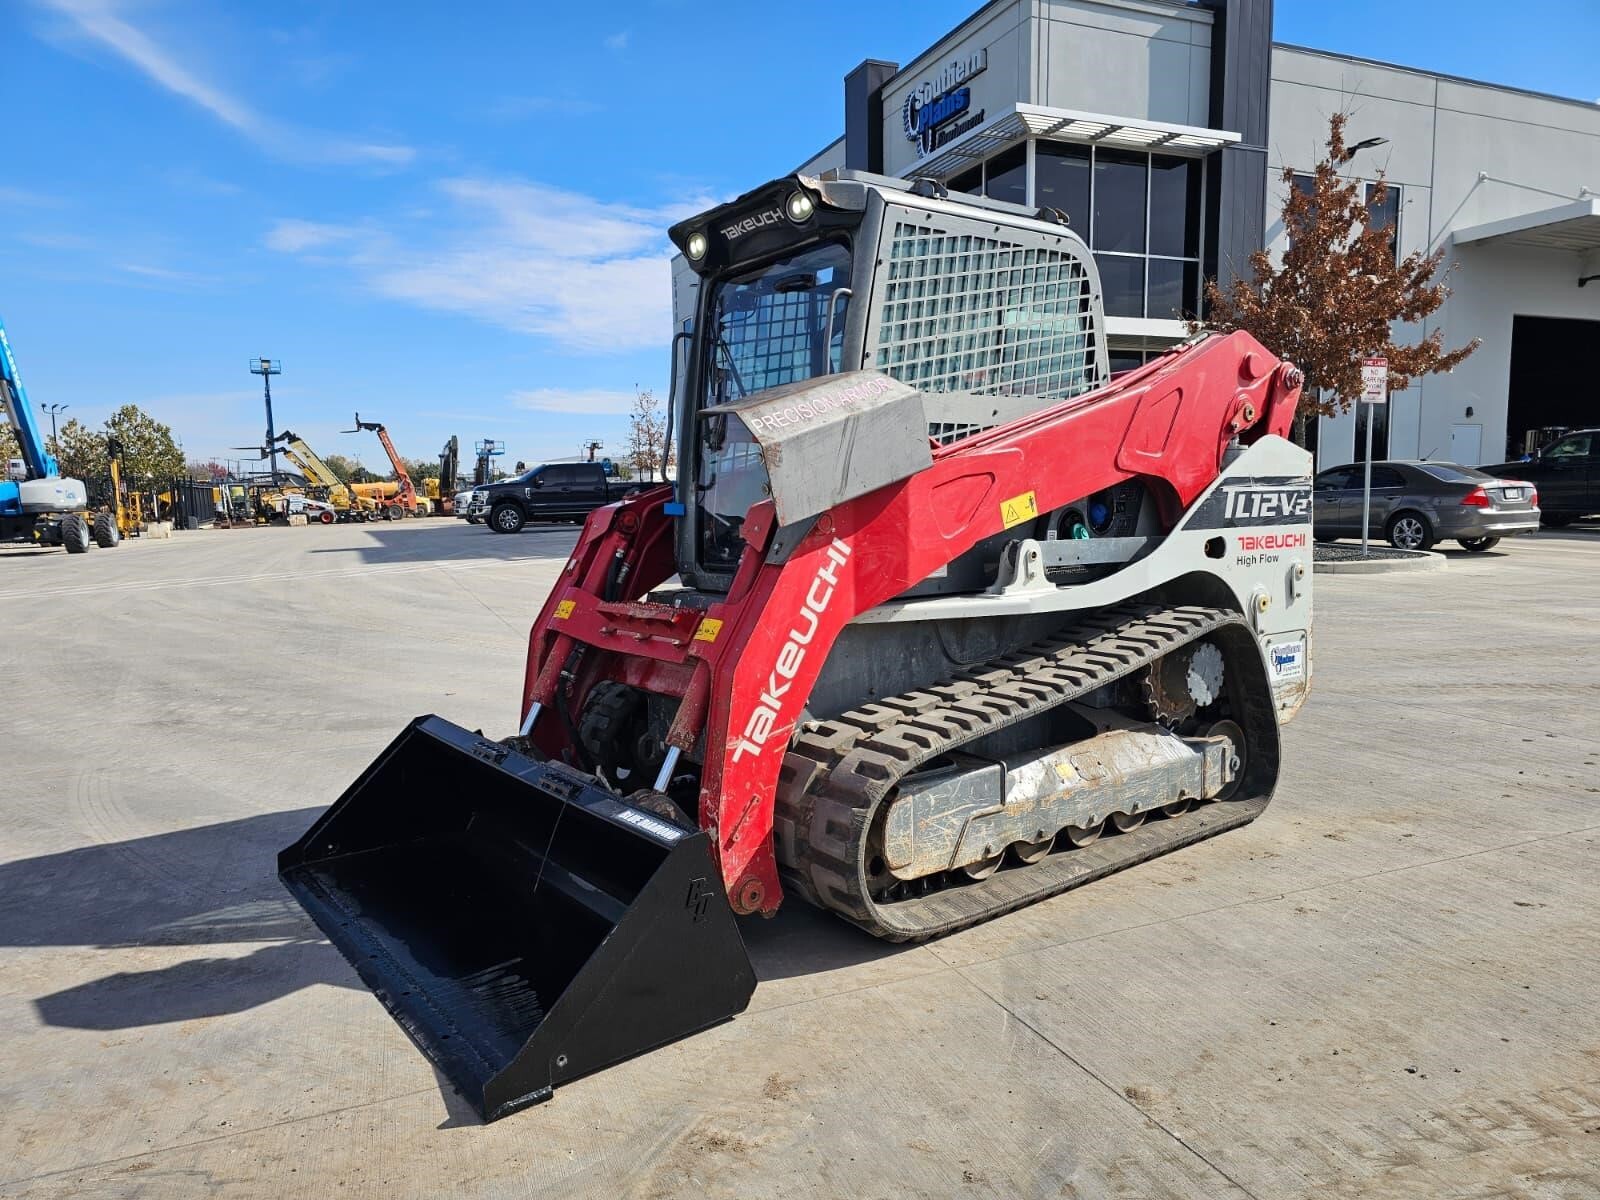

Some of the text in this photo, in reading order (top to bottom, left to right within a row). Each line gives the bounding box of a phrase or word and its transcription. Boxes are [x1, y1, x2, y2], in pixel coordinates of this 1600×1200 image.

[915, 50, 986, 108] Southern
[918, 88, 970, 133] Plains
[720, 207, 785, 240] TAKEUCH
[751, 377, 891, 434] PRECISION ARMOR
[1237, 533, 1306, 551] TAKEUCHI
[1237, 554, 1280, 567] High Flow
[732, 537, 853, 764] TAKEUCHI
